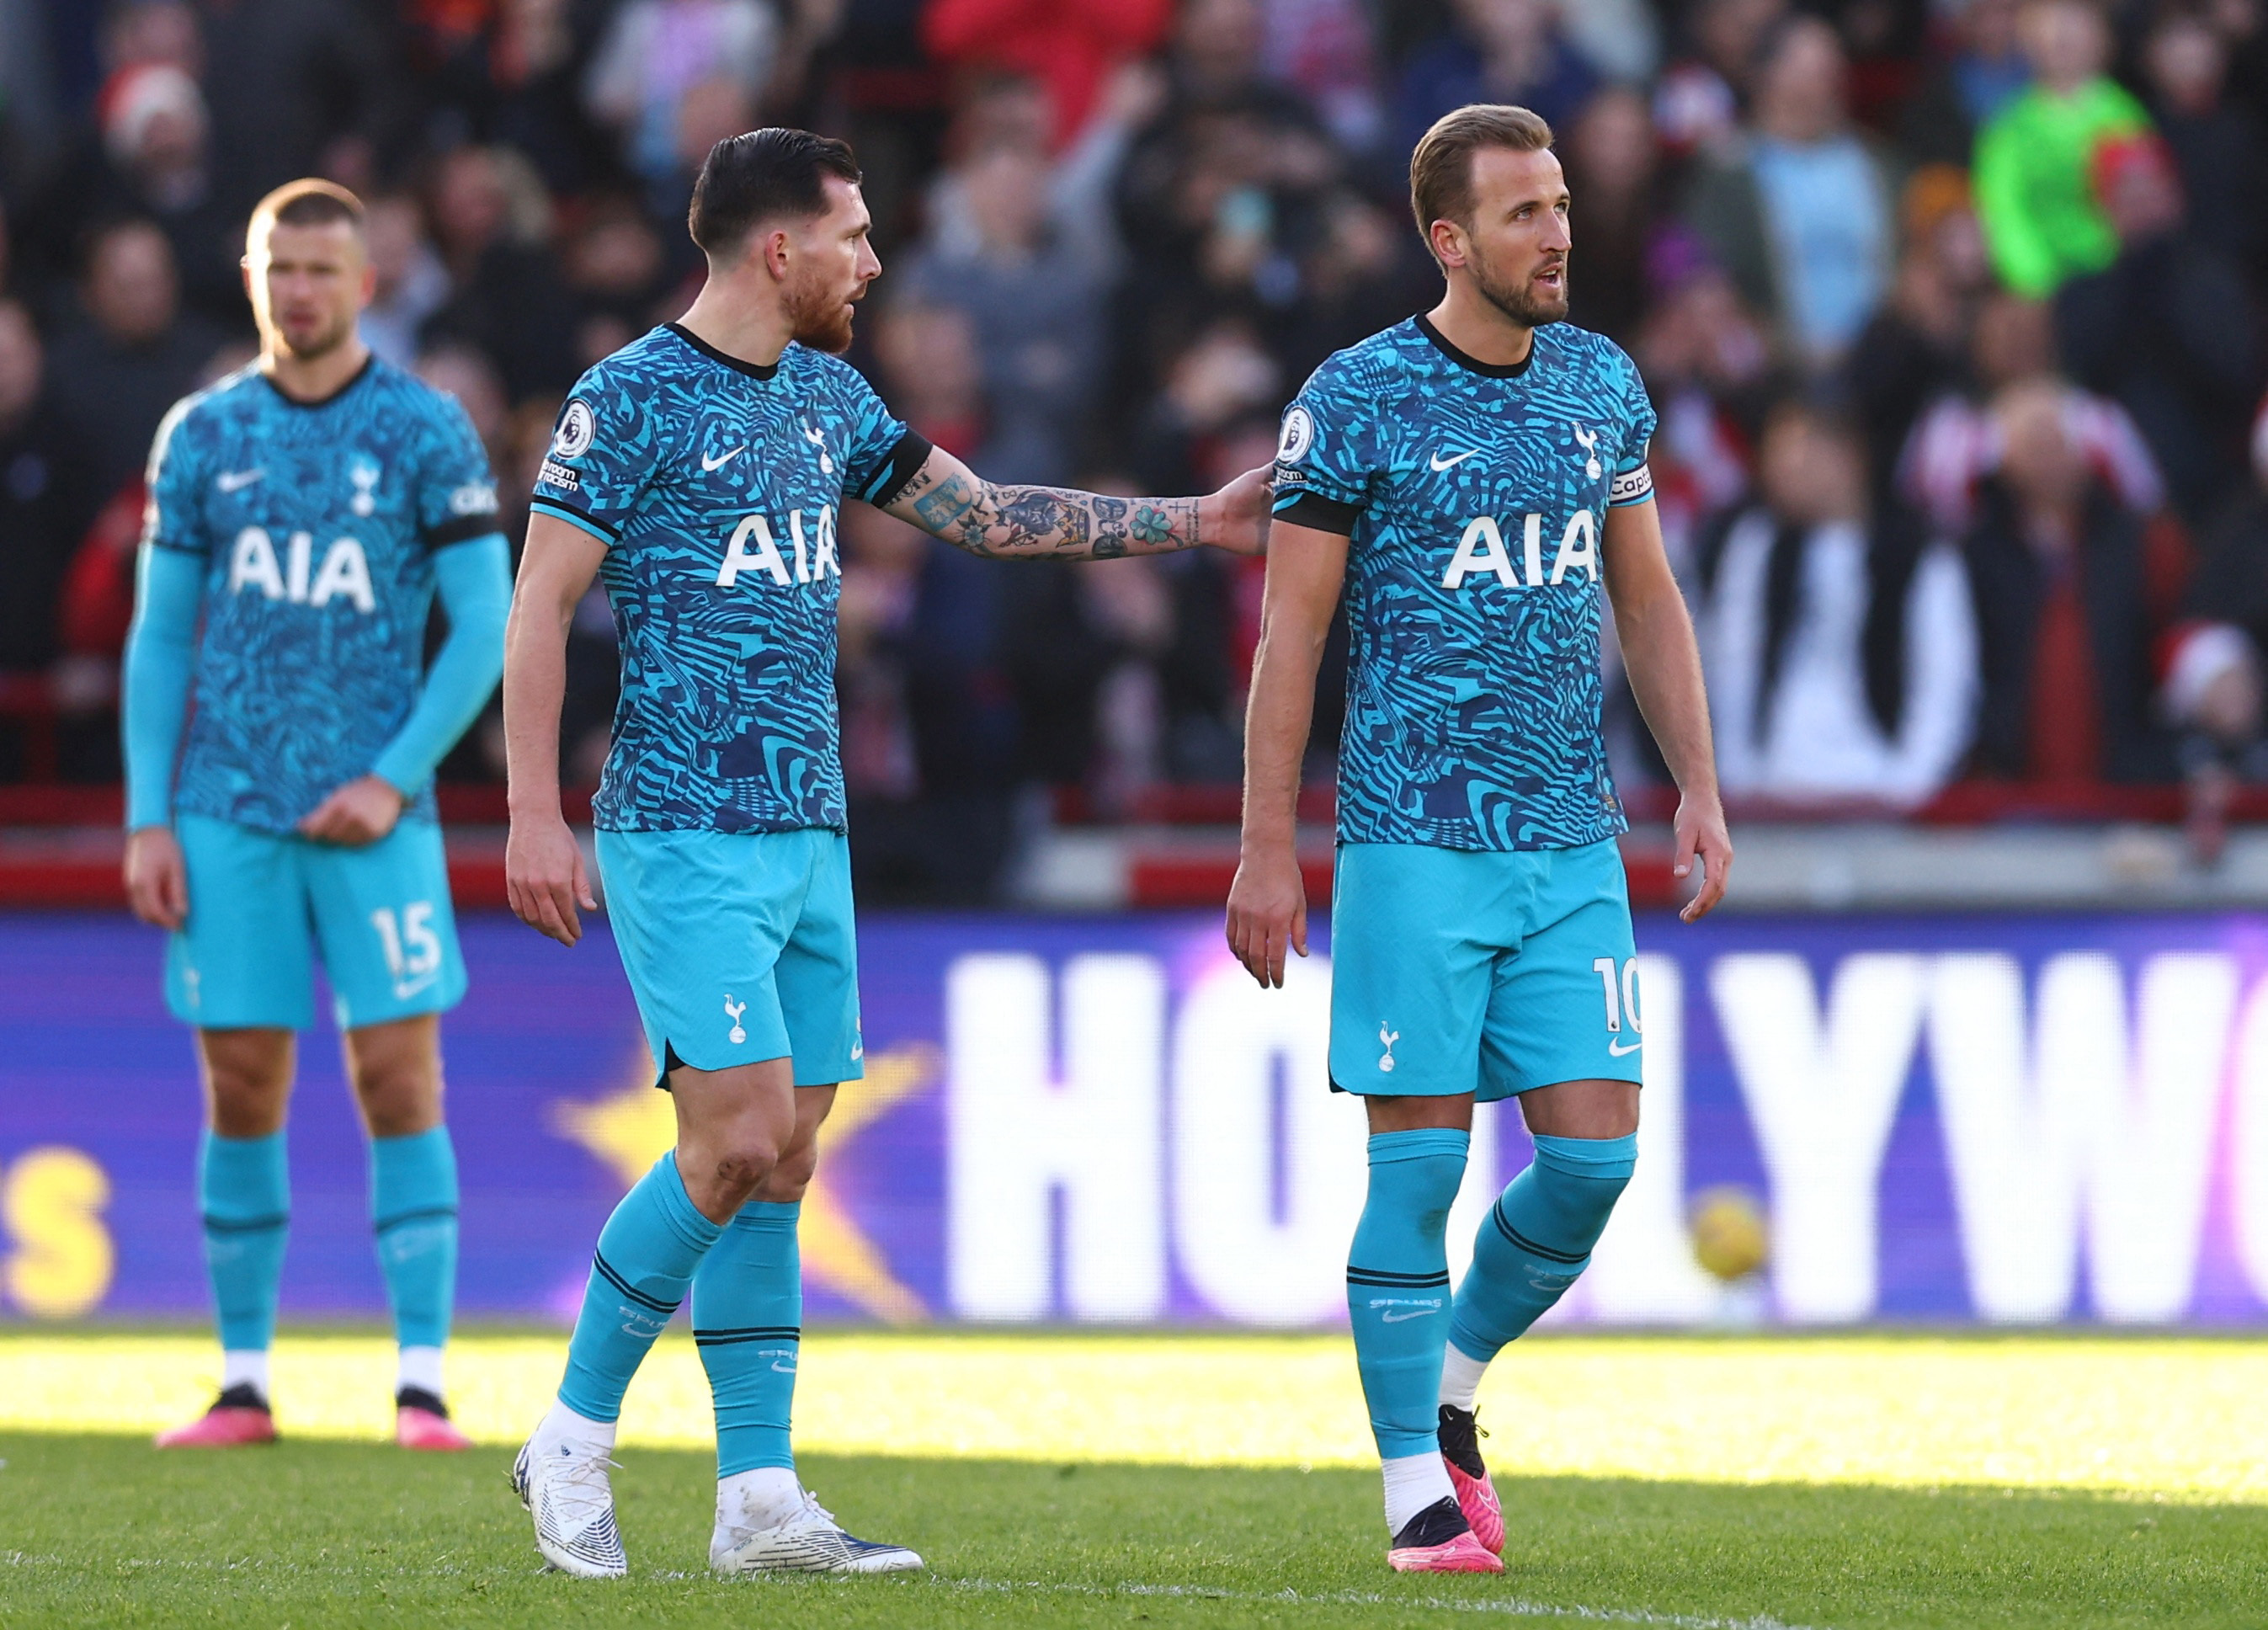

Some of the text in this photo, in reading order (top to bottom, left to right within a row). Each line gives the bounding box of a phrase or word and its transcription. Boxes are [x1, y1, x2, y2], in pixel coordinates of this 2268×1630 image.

[544, 472, 578, 492] racism
[549, 464, 577, 481] room
[232, 526, 375, 614] AIA
[716, 503, 842, 587] AIA
[1441, 509, 1597, 589] AIA
[371, 902, 441, 975] 15
